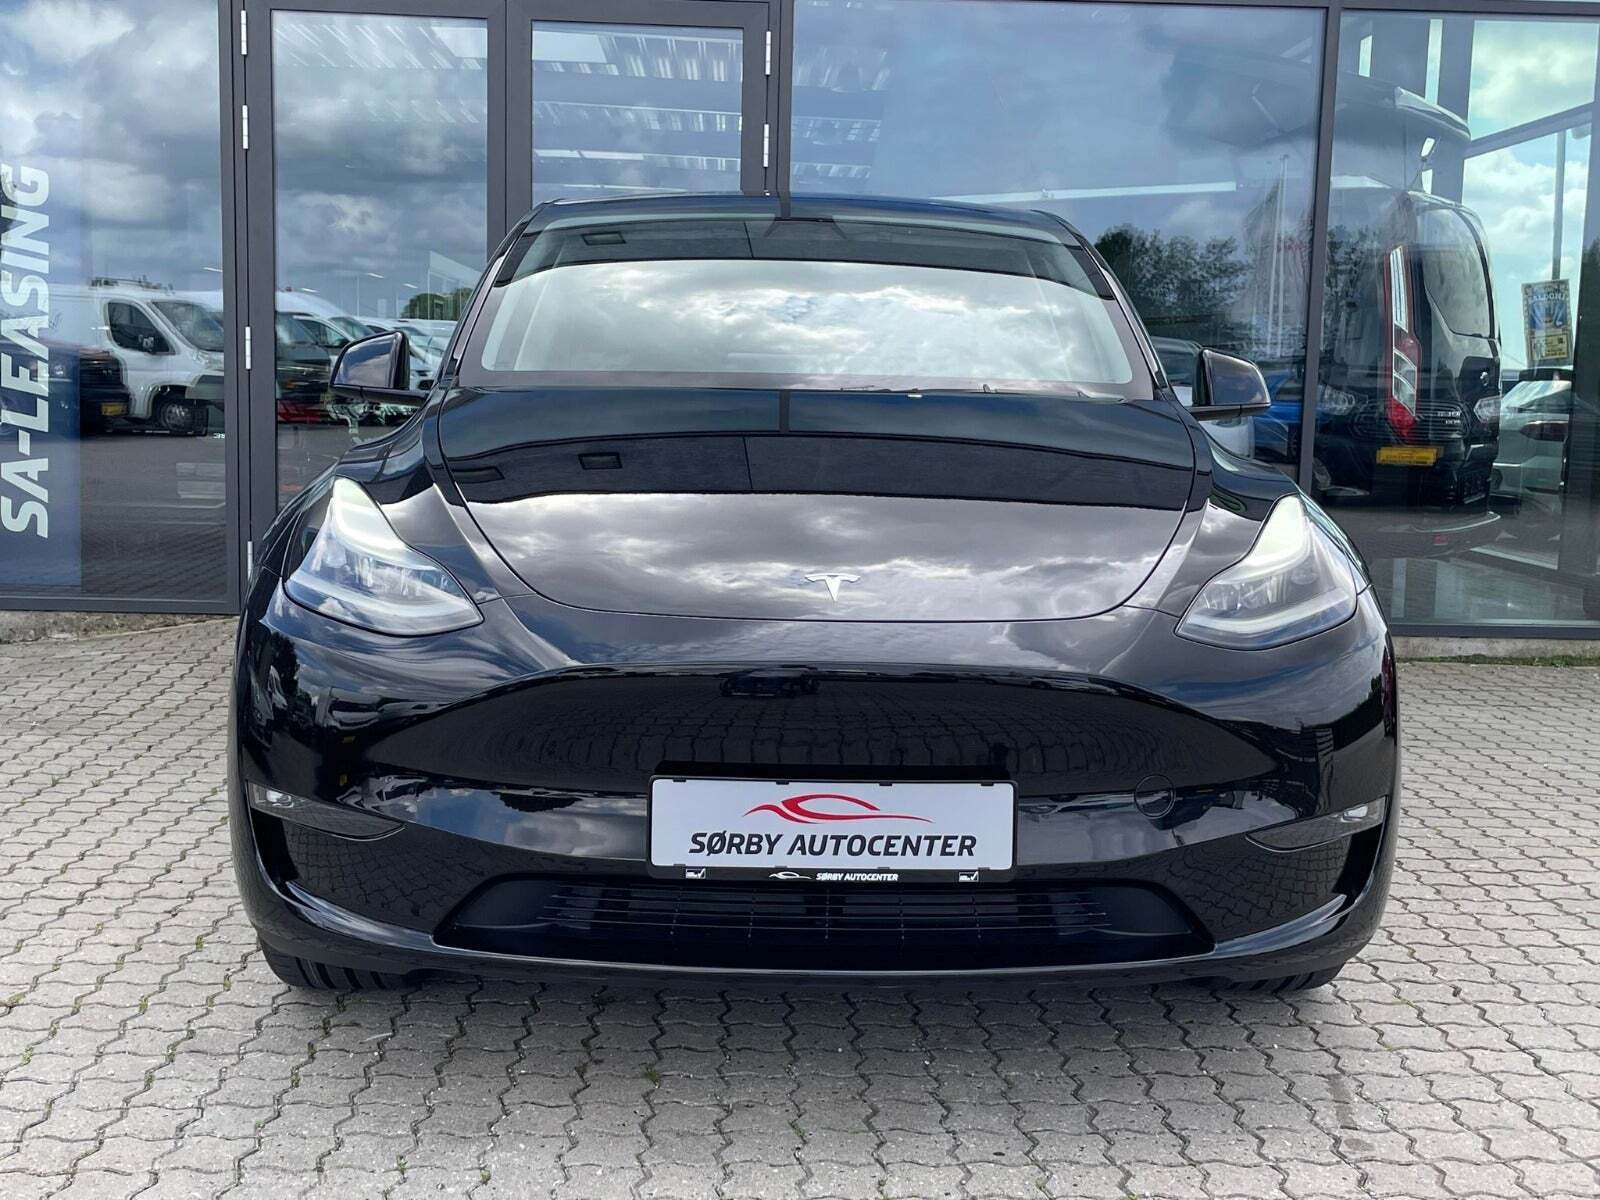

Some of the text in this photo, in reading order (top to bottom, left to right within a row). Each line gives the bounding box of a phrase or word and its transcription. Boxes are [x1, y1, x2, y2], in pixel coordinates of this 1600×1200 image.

[1, 163, 50, 539] SA-LEASING
[689, 831, 977, 857] SØRBY AUTOCENTER
[816, 872, 898, 881] SØRBY AUTOCENTER
